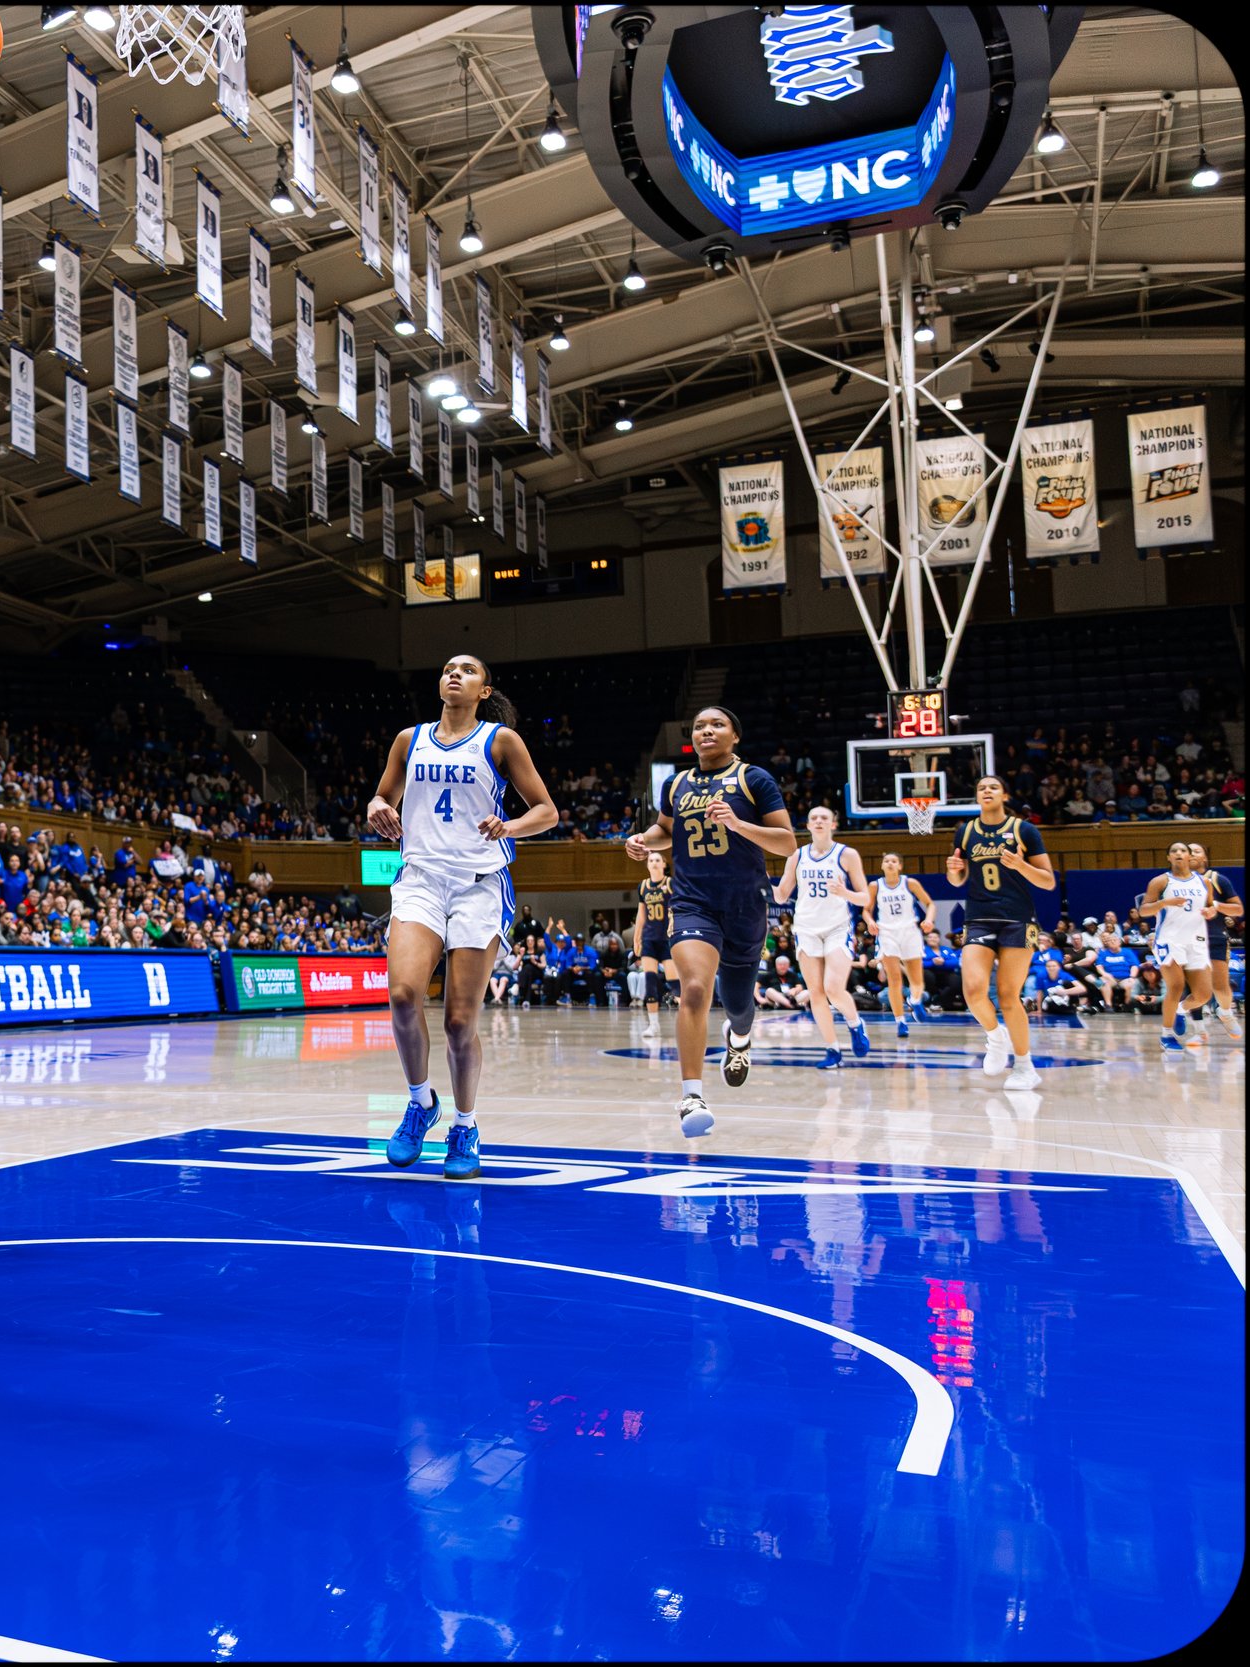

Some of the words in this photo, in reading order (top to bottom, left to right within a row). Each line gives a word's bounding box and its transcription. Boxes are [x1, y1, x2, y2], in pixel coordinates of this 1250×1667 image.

[832, 150, 911, 199] NC
[711, 158, 736, 207] NC
[1140, 424, 1195, 440] NATIONAL
[1031, 438, 1083, 454] NATIONAL
[1135, 438, 1203, 456] CHAMPIONS
[1026, 451, 1091, 470] CHAMPIONS
[728, 478, 775, 492] NATIONAL
[827, 477, 879, 492] HAMPIONS
[723, 490, 780, 506] CHAMPIONS
[1157, 515, 1192, 529] 2015
[1047, 526, 1080, 540] 2010
[939, 538, 970, 551] 2001
[846, 549, 868, 561] 992
[741, 560, 768, 572] 1991
[494, 568, 521, 580] DUKE
[900, 710, 937, 736] 28
[415, 763, 476, 784] DUKE
[434, 788, 454, 822] 4
[684, 818, 730, 858] 23
[802, 869, 834, 879] DUKE
[982, 863, 1001, 891] 8
[808, 881, 828, 898] 35
[1173, 888, 1202, 897] DUKE
[883, 894, 906, 902] DUKE
[1184, 898, 1193, 912] 3
[648, 904, 664, 921] 30
[890, 904, 902, 915] 12
[254, 969, 265, 981] OLD
[266, 968, 296, 981] DOMINION
[257, 982, 283, 995] FREIGHT
[283, 981, 297, 994] LINE
